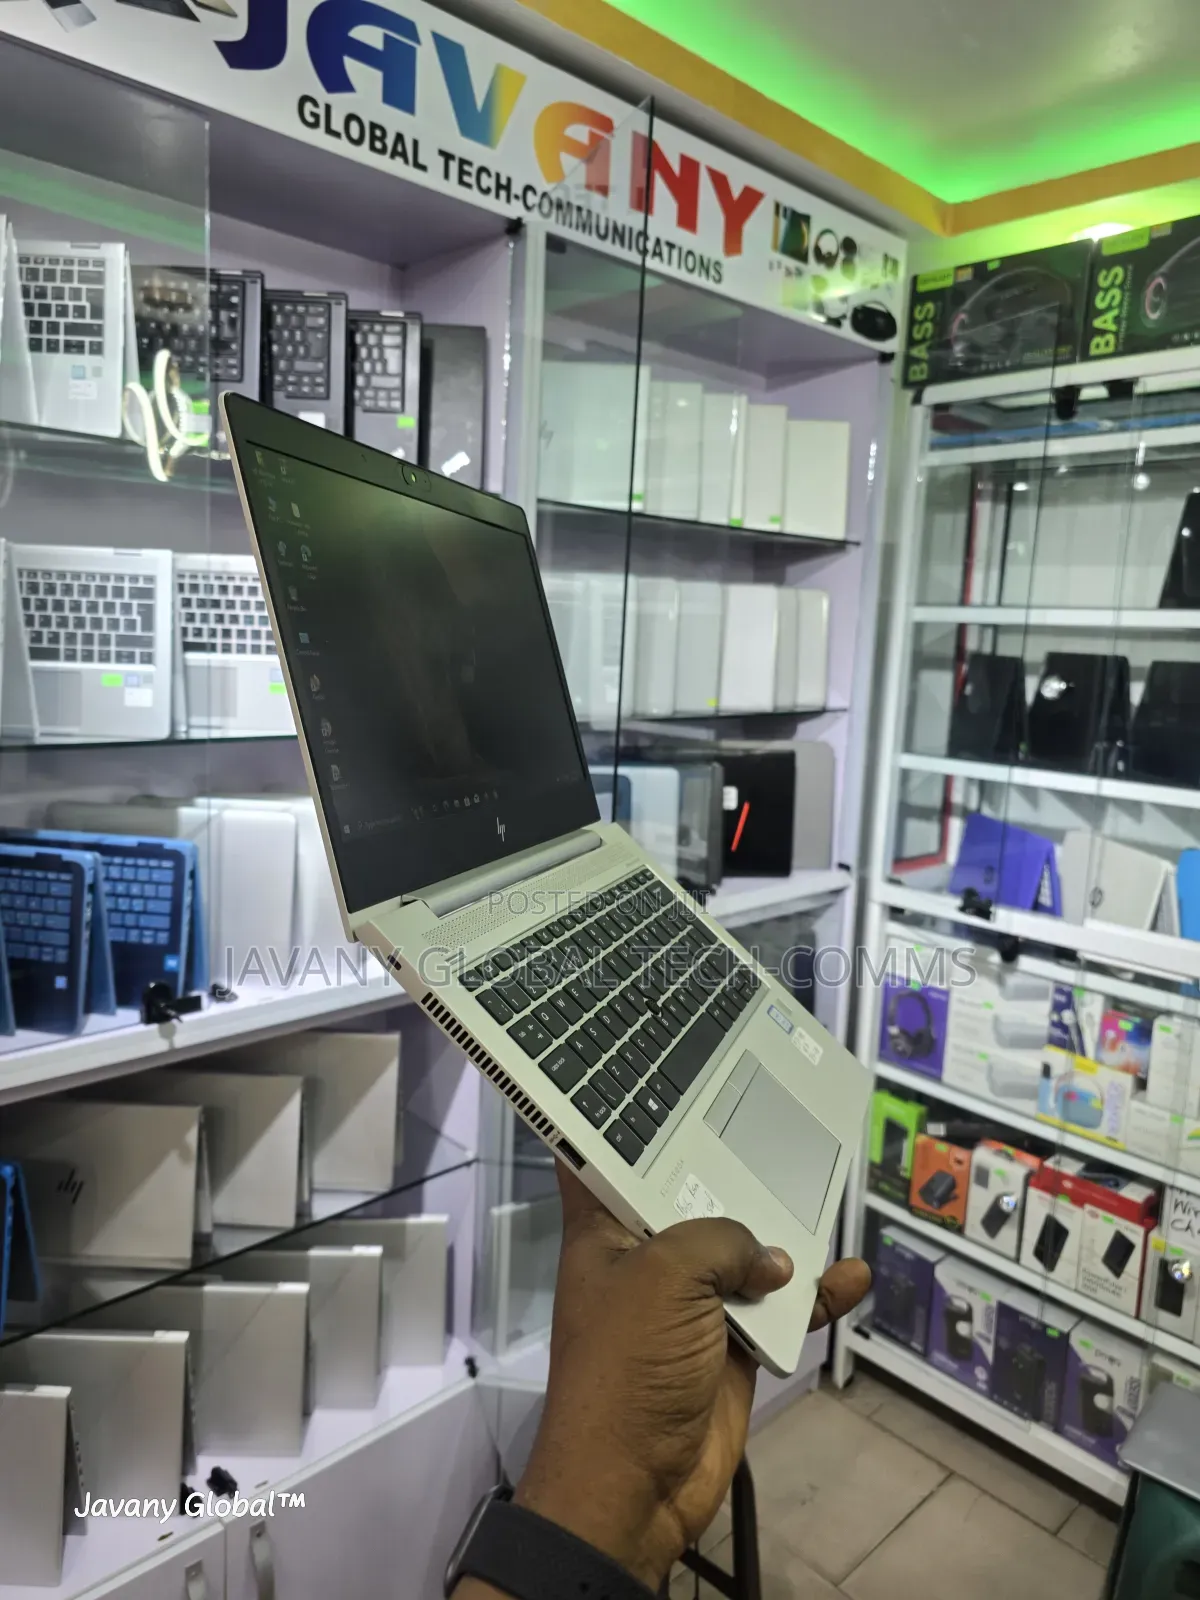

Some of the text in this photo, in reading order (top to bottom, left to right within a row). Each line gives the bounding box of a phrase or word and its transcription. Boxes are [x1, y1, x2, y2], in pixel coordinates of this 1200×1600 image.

[213, 0, 763, 258] JAVANY
[297, 94, 723, 285] GLOBAL TECH-COMMUNICATIONS
[1089, 265, 1125, 356] BASS
[908, 301, 935, 382] BASS
[572, 988, 578, 996] E
[557, 998, 565, 1007] W
[616, 1004, 621, 1012] F
[539, 1011, 550, 1021] Q
[661, 1017, 669, 1026] B
[589, 1027, 597, 1036] S
[576, 1041, 583, 1049] A
[638, 1039, 644, 1047] C
[626, 1052, 632, 1060] X
[612, 1066, 619, 1075] Z
[1171, 1218, 1200, 1238] Ch
